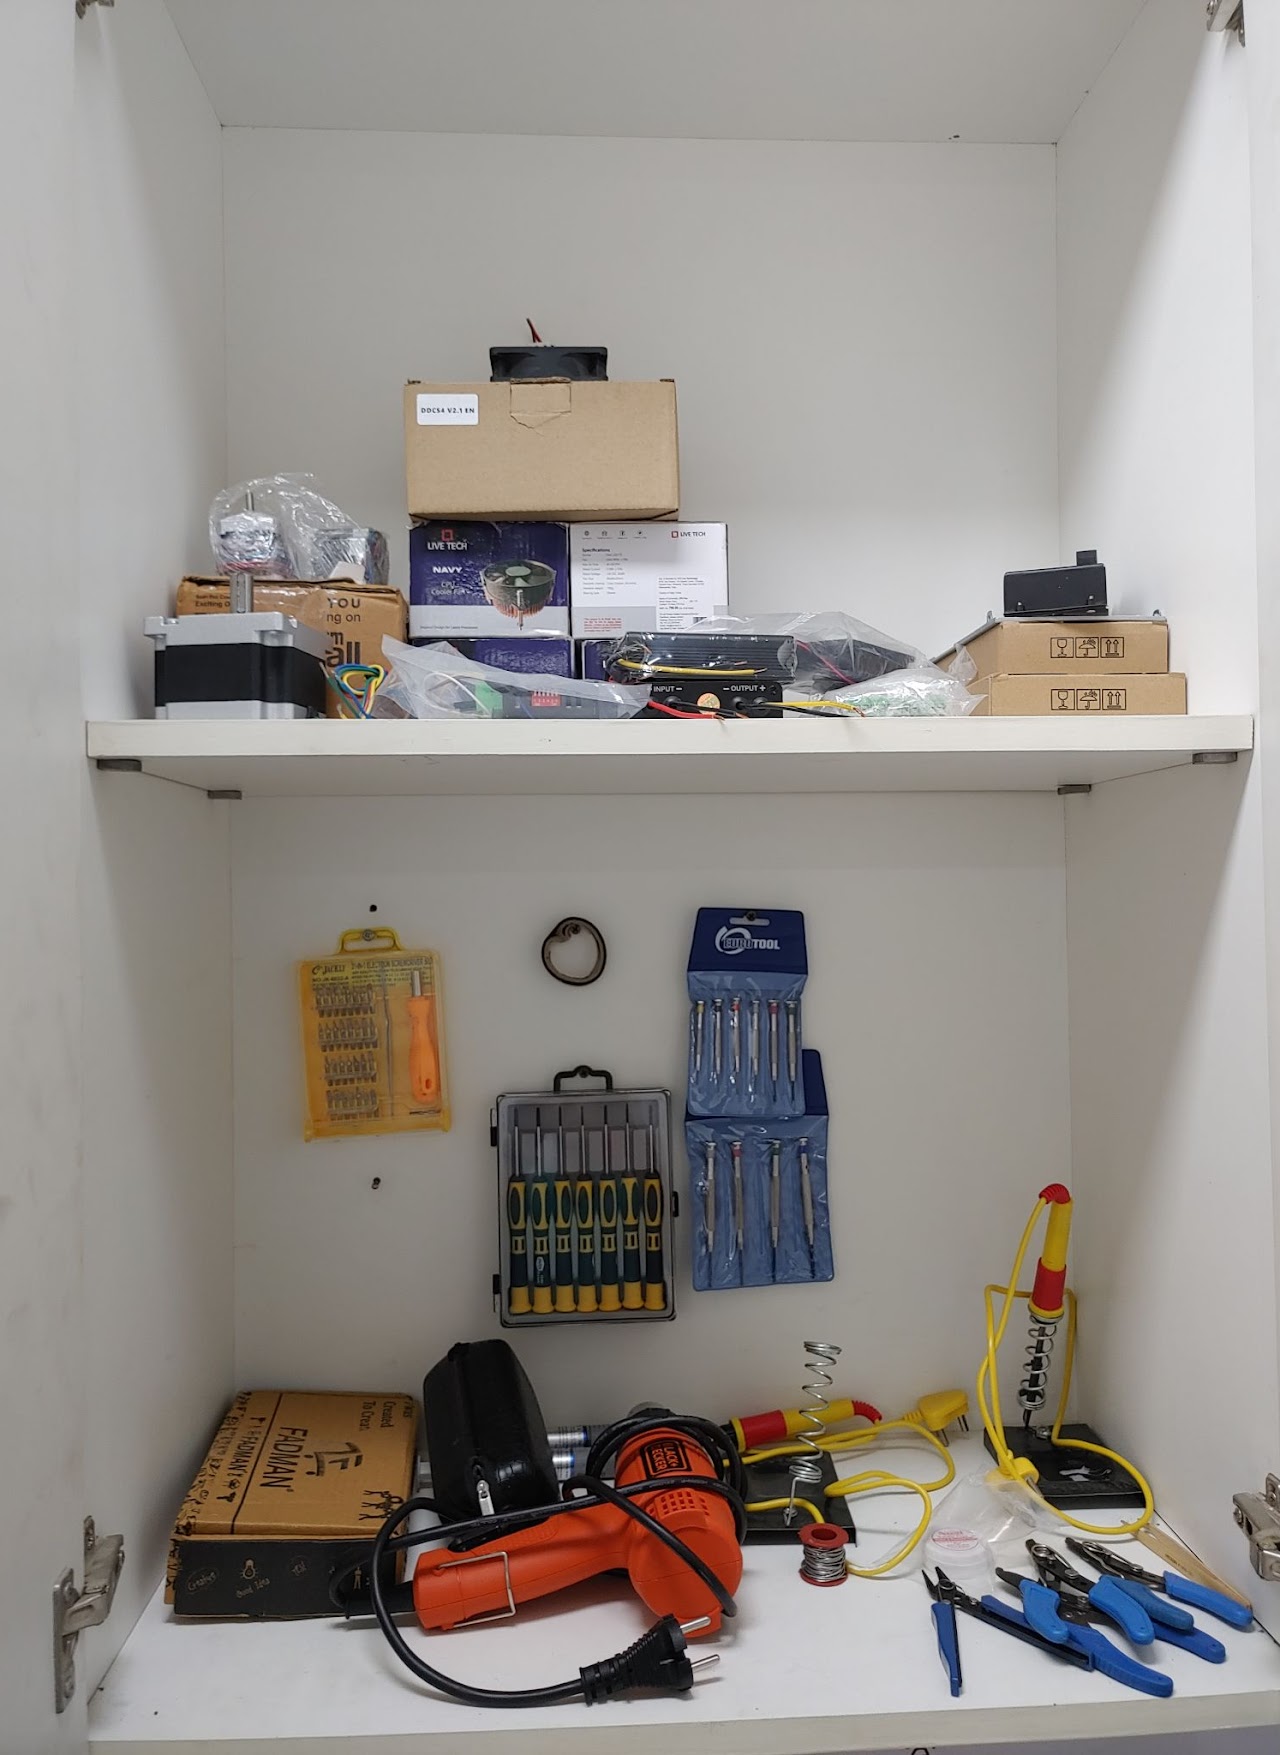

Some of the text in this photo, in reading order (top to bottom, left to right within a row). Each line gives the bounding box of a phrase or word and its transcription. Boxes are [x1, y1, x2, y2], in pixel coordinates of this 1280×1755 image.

[427, 541, 467, 550] LIVE TECH
[345, 613, 361, 623] on
[362, 1401, 377, 1410] To
[380, 1401, 397, 1428] Created
[260, 1426, 308, 1490] FADMAN
